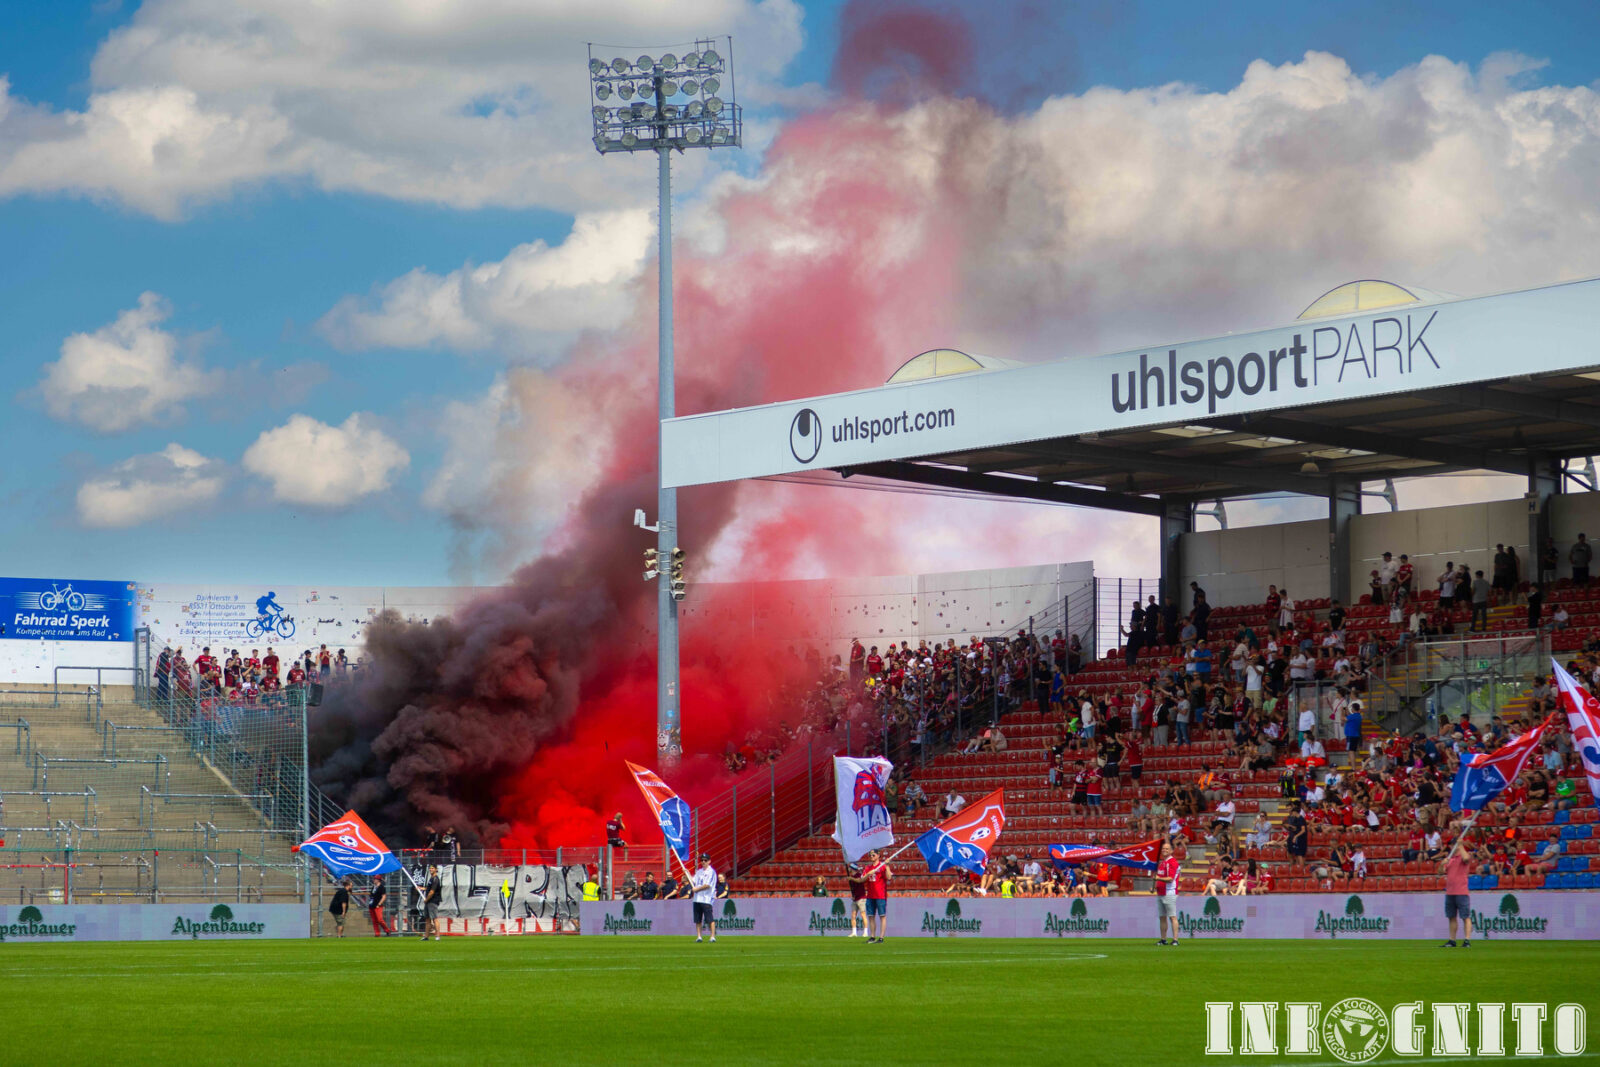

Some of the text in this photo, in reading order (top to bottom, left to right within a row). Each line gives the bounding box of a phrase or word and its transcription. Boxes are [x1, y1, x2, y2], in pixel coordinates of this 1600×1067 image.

[832, 408, 955, 443] uhlsport.com
[14, 612, 110, 630] Fahrrad Sperk
[15, 627, 56, 636] Kompetenz
[91, 629, 106, 637] Rad
[185, 620, 239, 628] Meisterwerkstatt
[171, 916, 265, 938] Alpenbauer
[603, 912, 653, 935] Alpenbauer
[702, 915, 755, 935] penbauer
[921, 911, 982, 936] Alpenbauer
[1044, 911, 1110, 936] Alpenbauer
[1178, 910, 1244, 937] Alpenbauer
[1315, 909, 1390, 937] Alpenbauer
[1471, 909, 1548, 937] Alpenbauer
